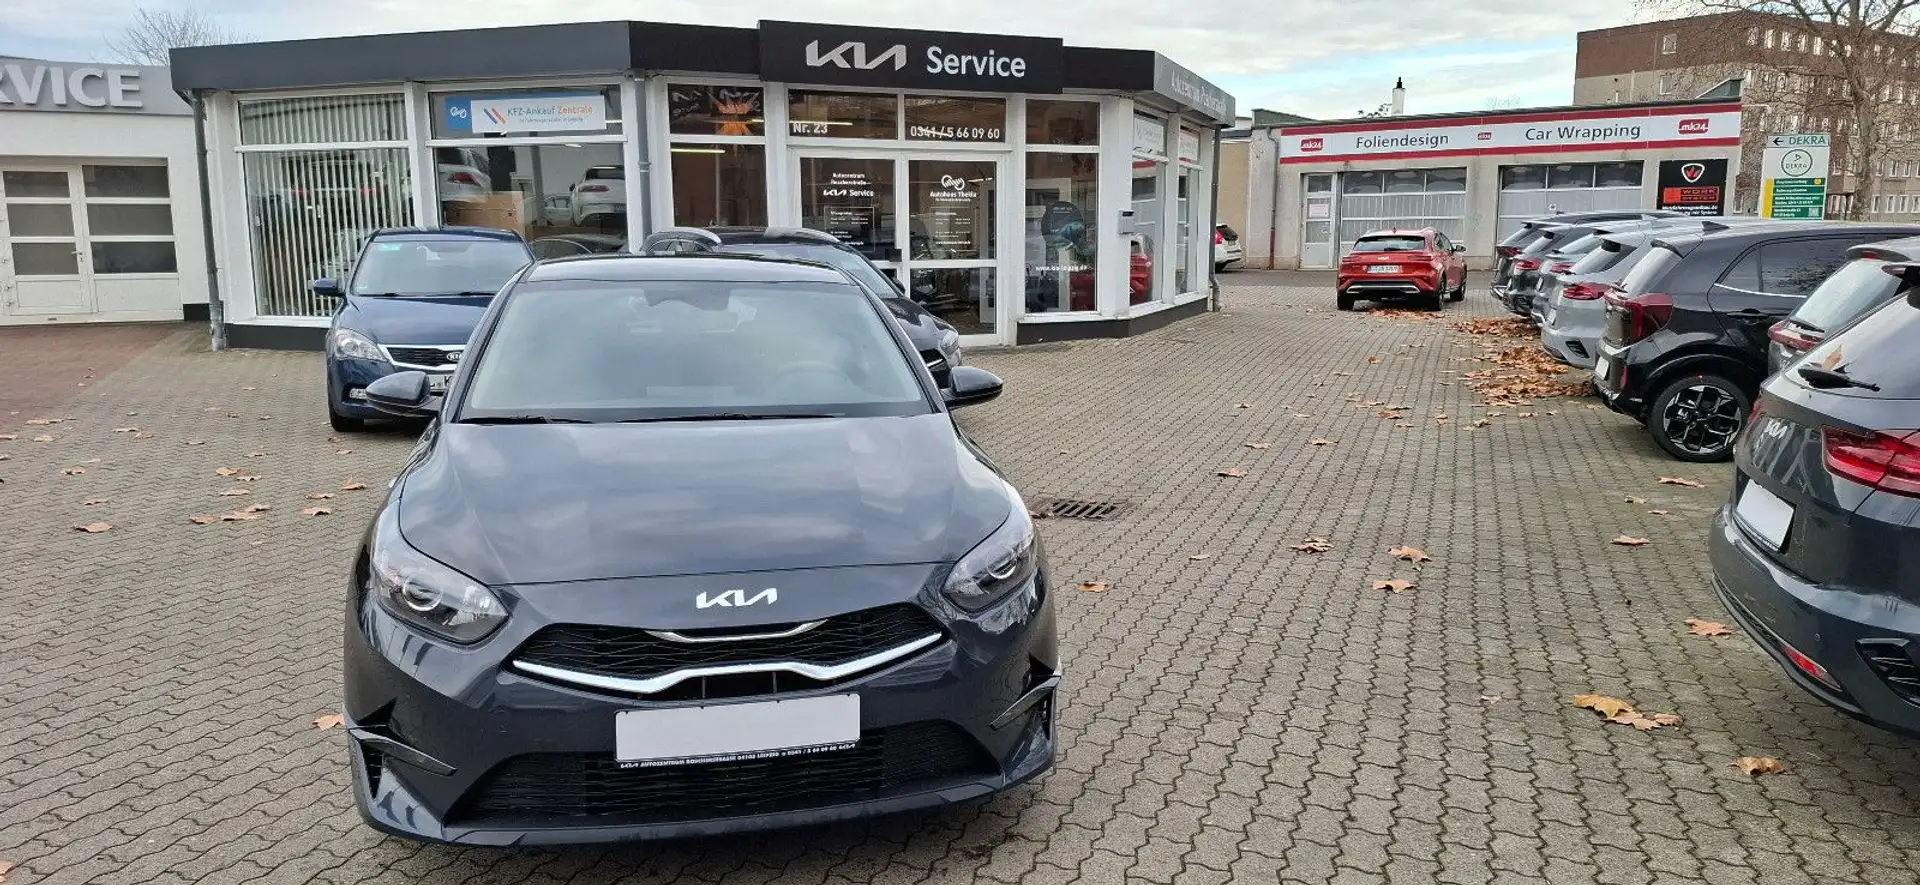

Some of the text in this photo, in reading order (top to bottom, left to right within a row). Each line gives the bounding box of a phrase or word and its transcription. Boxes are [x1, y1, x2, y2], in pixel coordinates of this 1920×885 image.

[806, 40, 1026, 78] KIA Service
[507, 103, 593, 117] KFZ-Ankauf Zentrale
[792, 122, 828, 134] Nr. 23
[956, 127, 969, 138] 66
[972, 127, 984, 139] 09
[987, 128, 1000, 139] 60
[1525, 123, 1641, 141] Car Wrapping
[1356, 133, 1449, 150] Foliendesign
[1789, 136, 1826, 145] DEKRA
[849, 189, 875, 197] Service
[695, 587, 778, 609] KIA
[640, 760, 685, 768] AUTOZENTRUM
